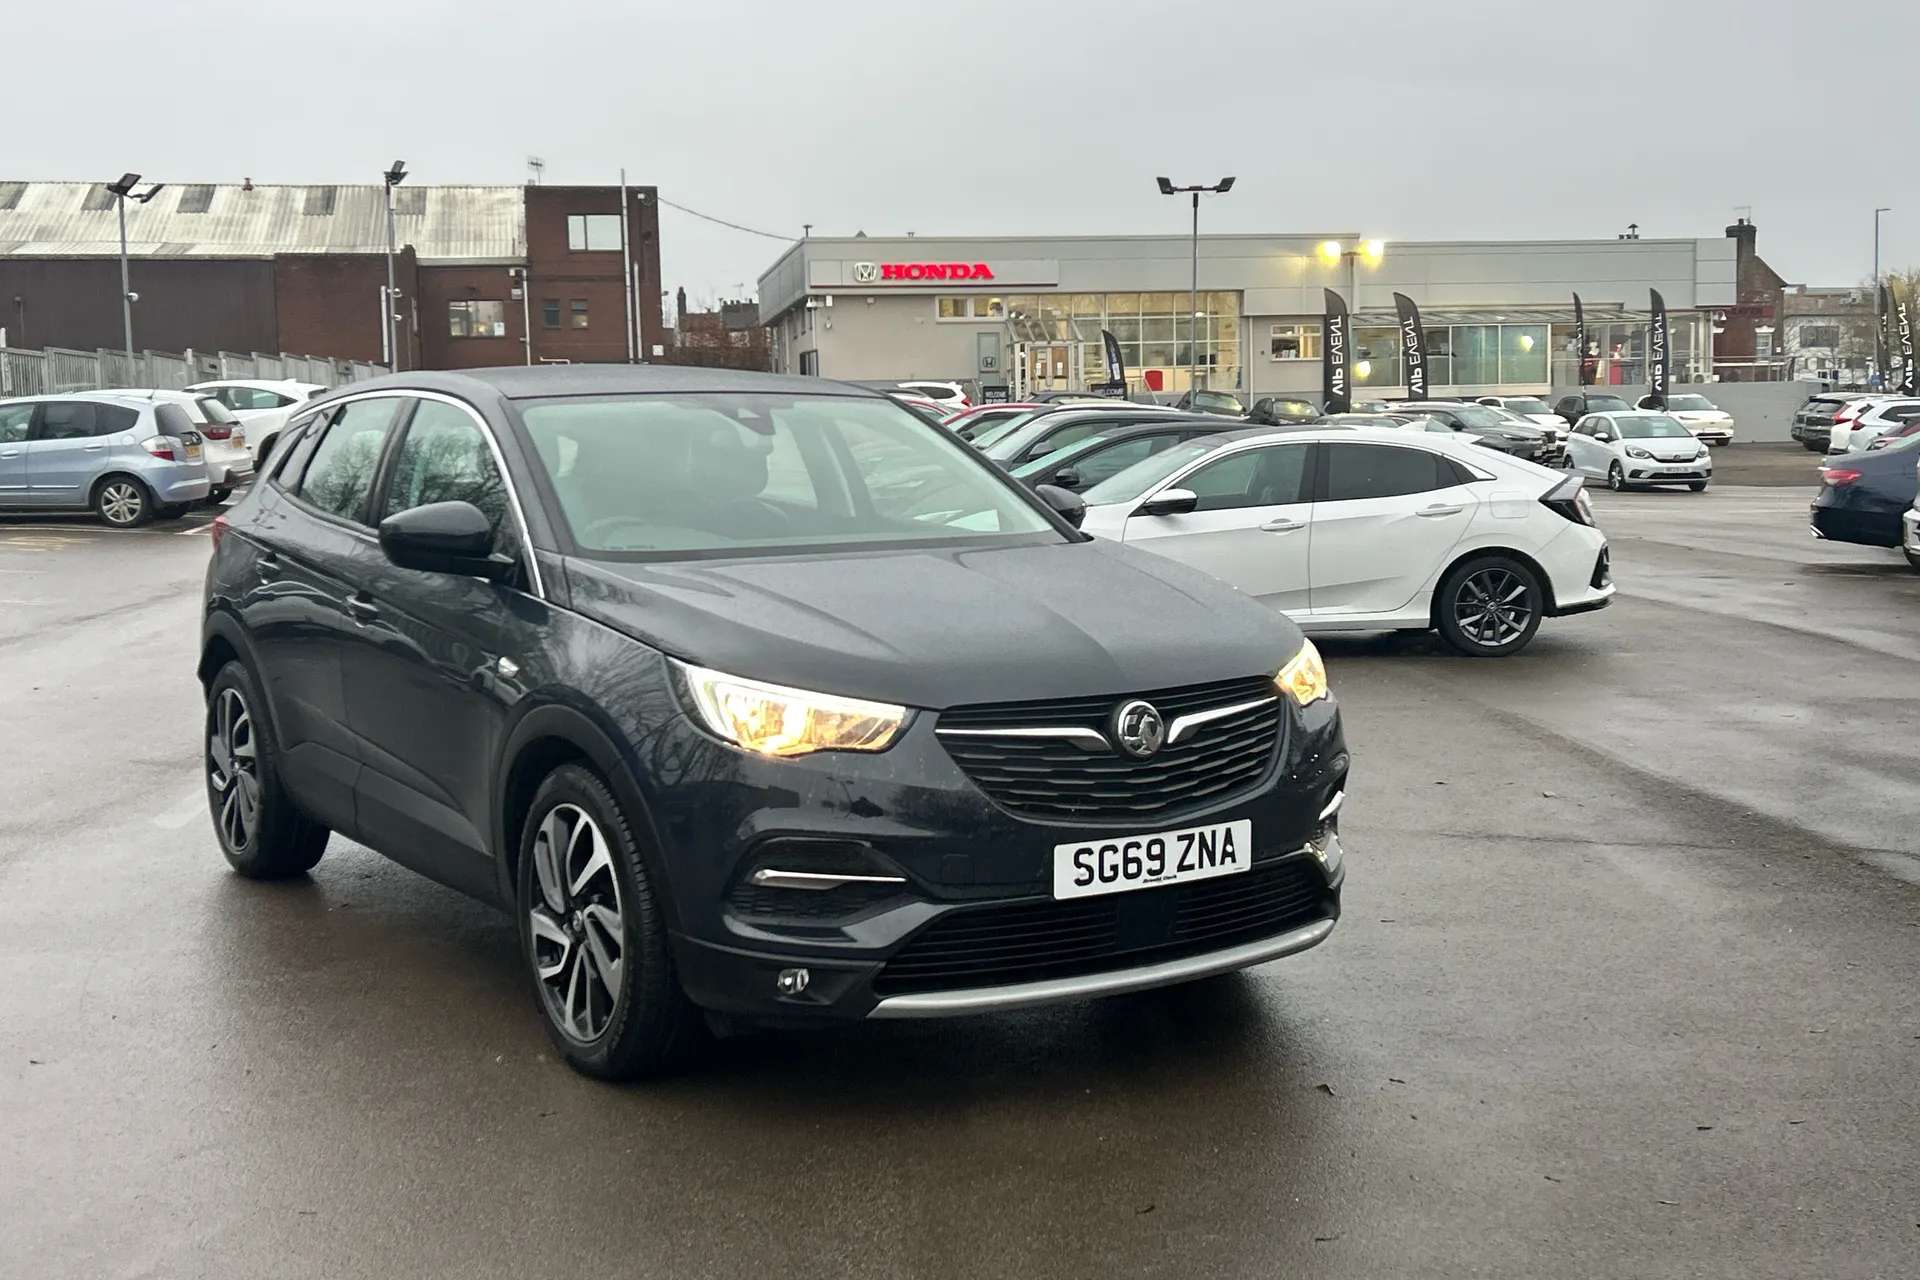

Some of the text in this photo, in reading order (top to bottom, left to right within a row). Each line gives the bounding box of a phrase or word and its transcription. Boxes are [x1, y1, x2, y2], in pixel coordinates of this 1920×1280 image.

[881, 263, 994, 280] HONDA
[1074, 827, 1237, 887] SG69 ZNA
